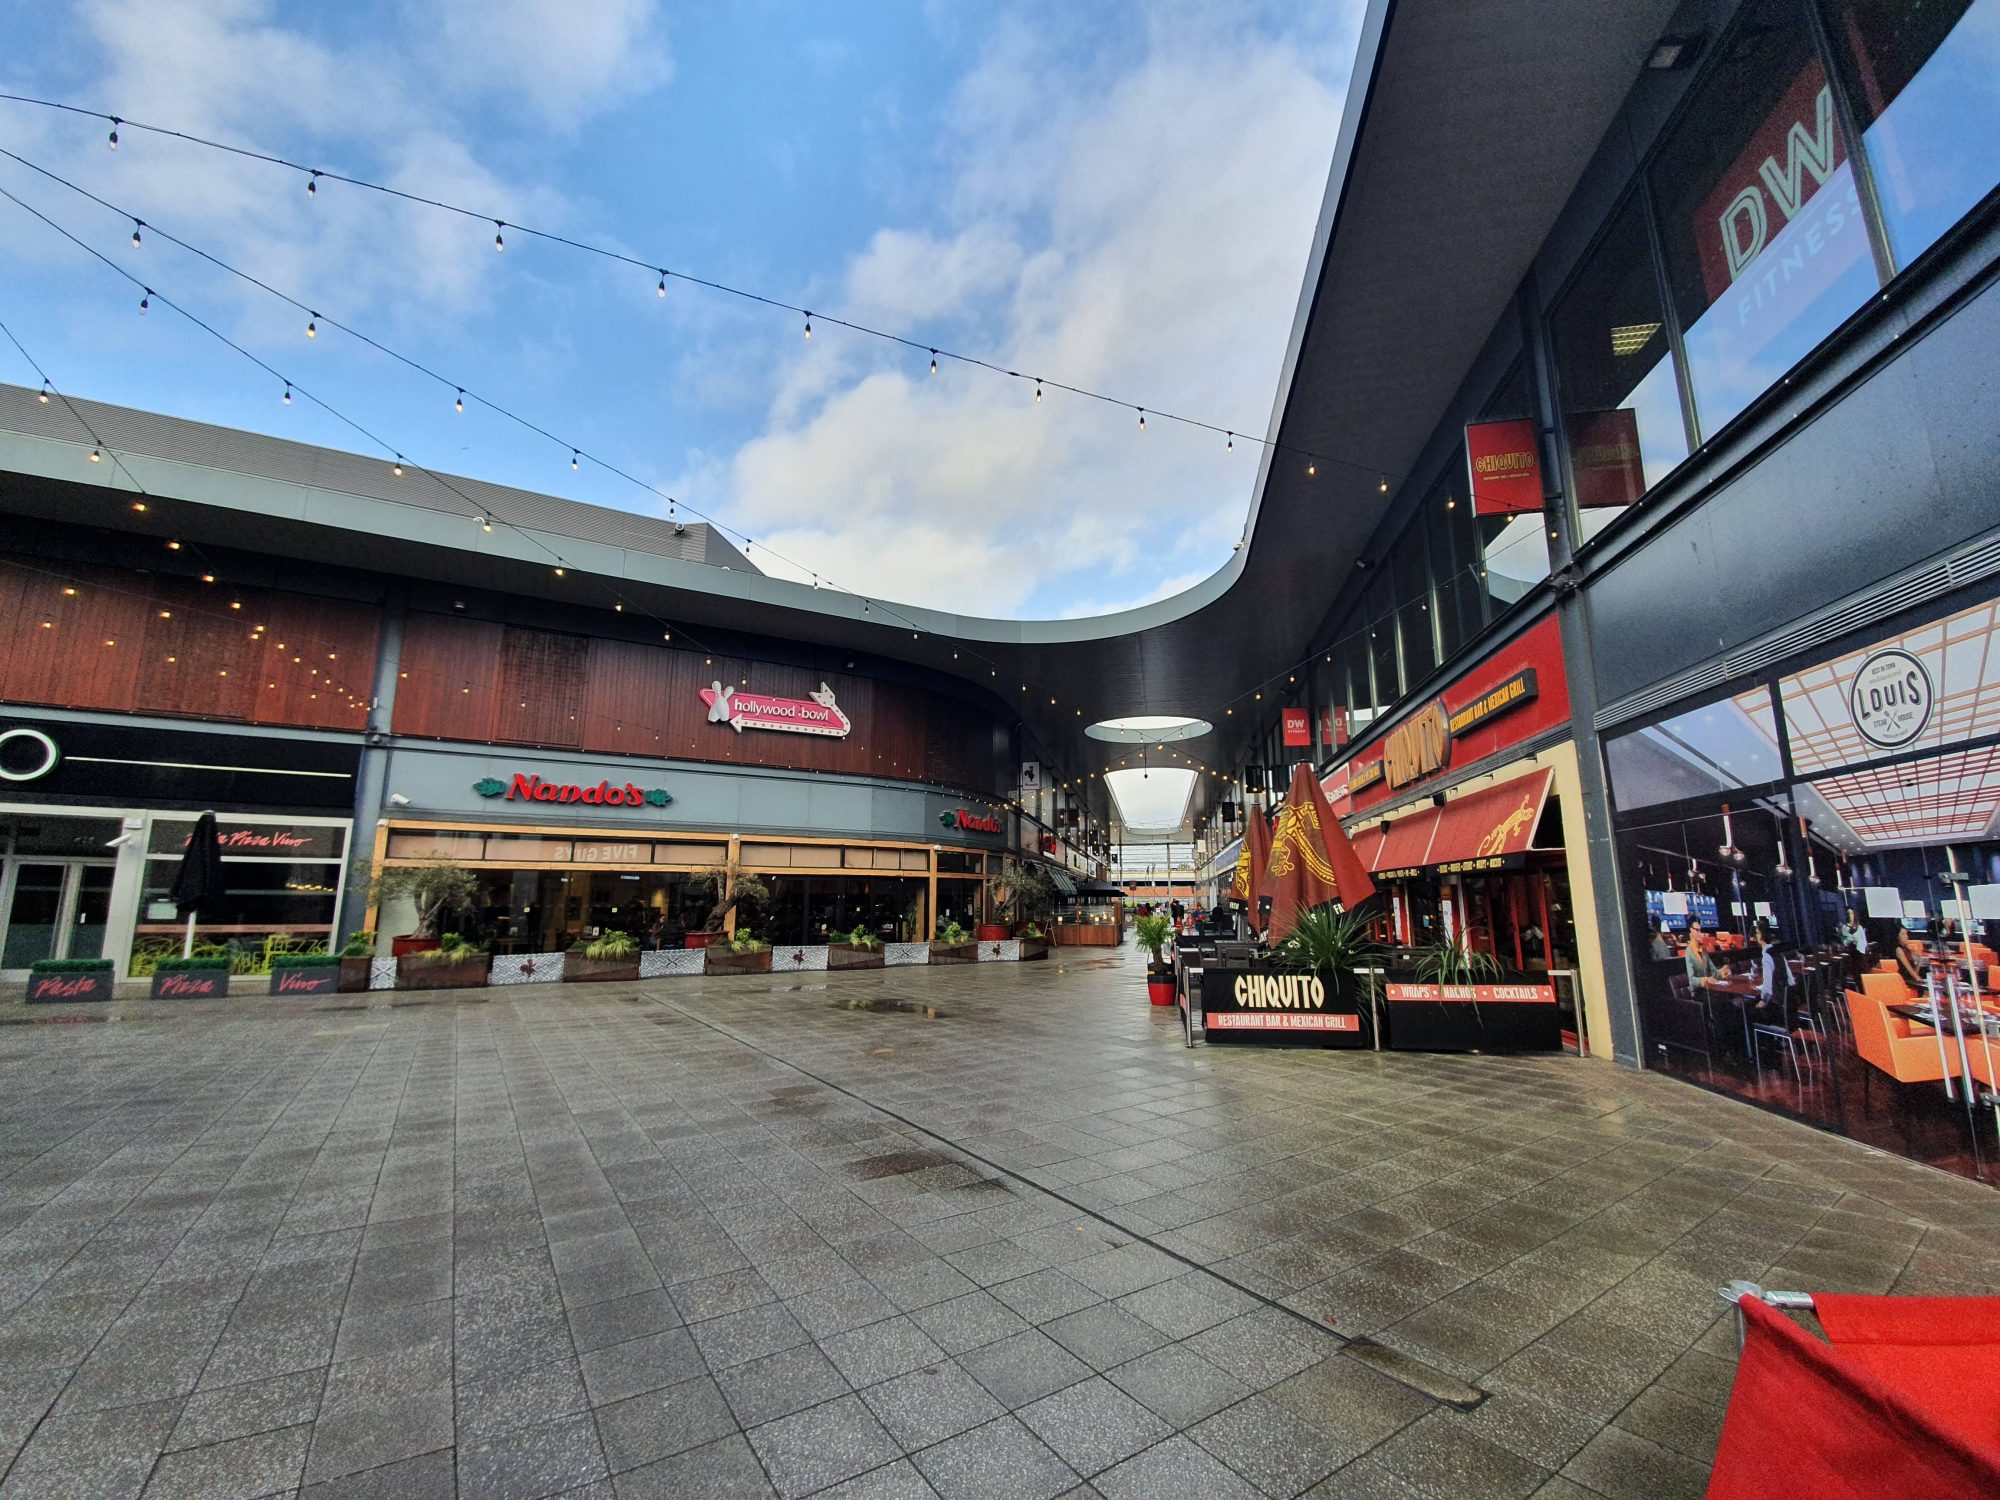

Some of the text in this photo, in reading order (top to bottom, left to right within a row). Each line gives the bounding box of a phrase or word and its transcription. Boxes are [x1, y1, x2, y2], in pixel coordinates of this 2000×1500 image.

[1719, 84, 1835, 282] DW
[1476, 451, 1534, 472] CHIQUITO
[1857, 671, 1921, 720] LOUIS
[734, 698, 829, 721] hollywood bowl
[1287, 719, 1305, 729] DW
[504, 772, 644, 807] Nando's
[228, 830, 271, 846] Pizza
[272, 831, 312, 847] Vino
[35, 975, 97, 999] Pasta
[160, 974, 214, 995] Pizza
[279, 971, 332, 992] Vino
[1234, 975, 1325, 1009] CHIQUITO
[1400, 986, 1538, 999] WRAPS NACHOS COCKTAILS
[1218, 1014, 1347, 1029] RESTAURANT BAR & MEXICAN GRILL
